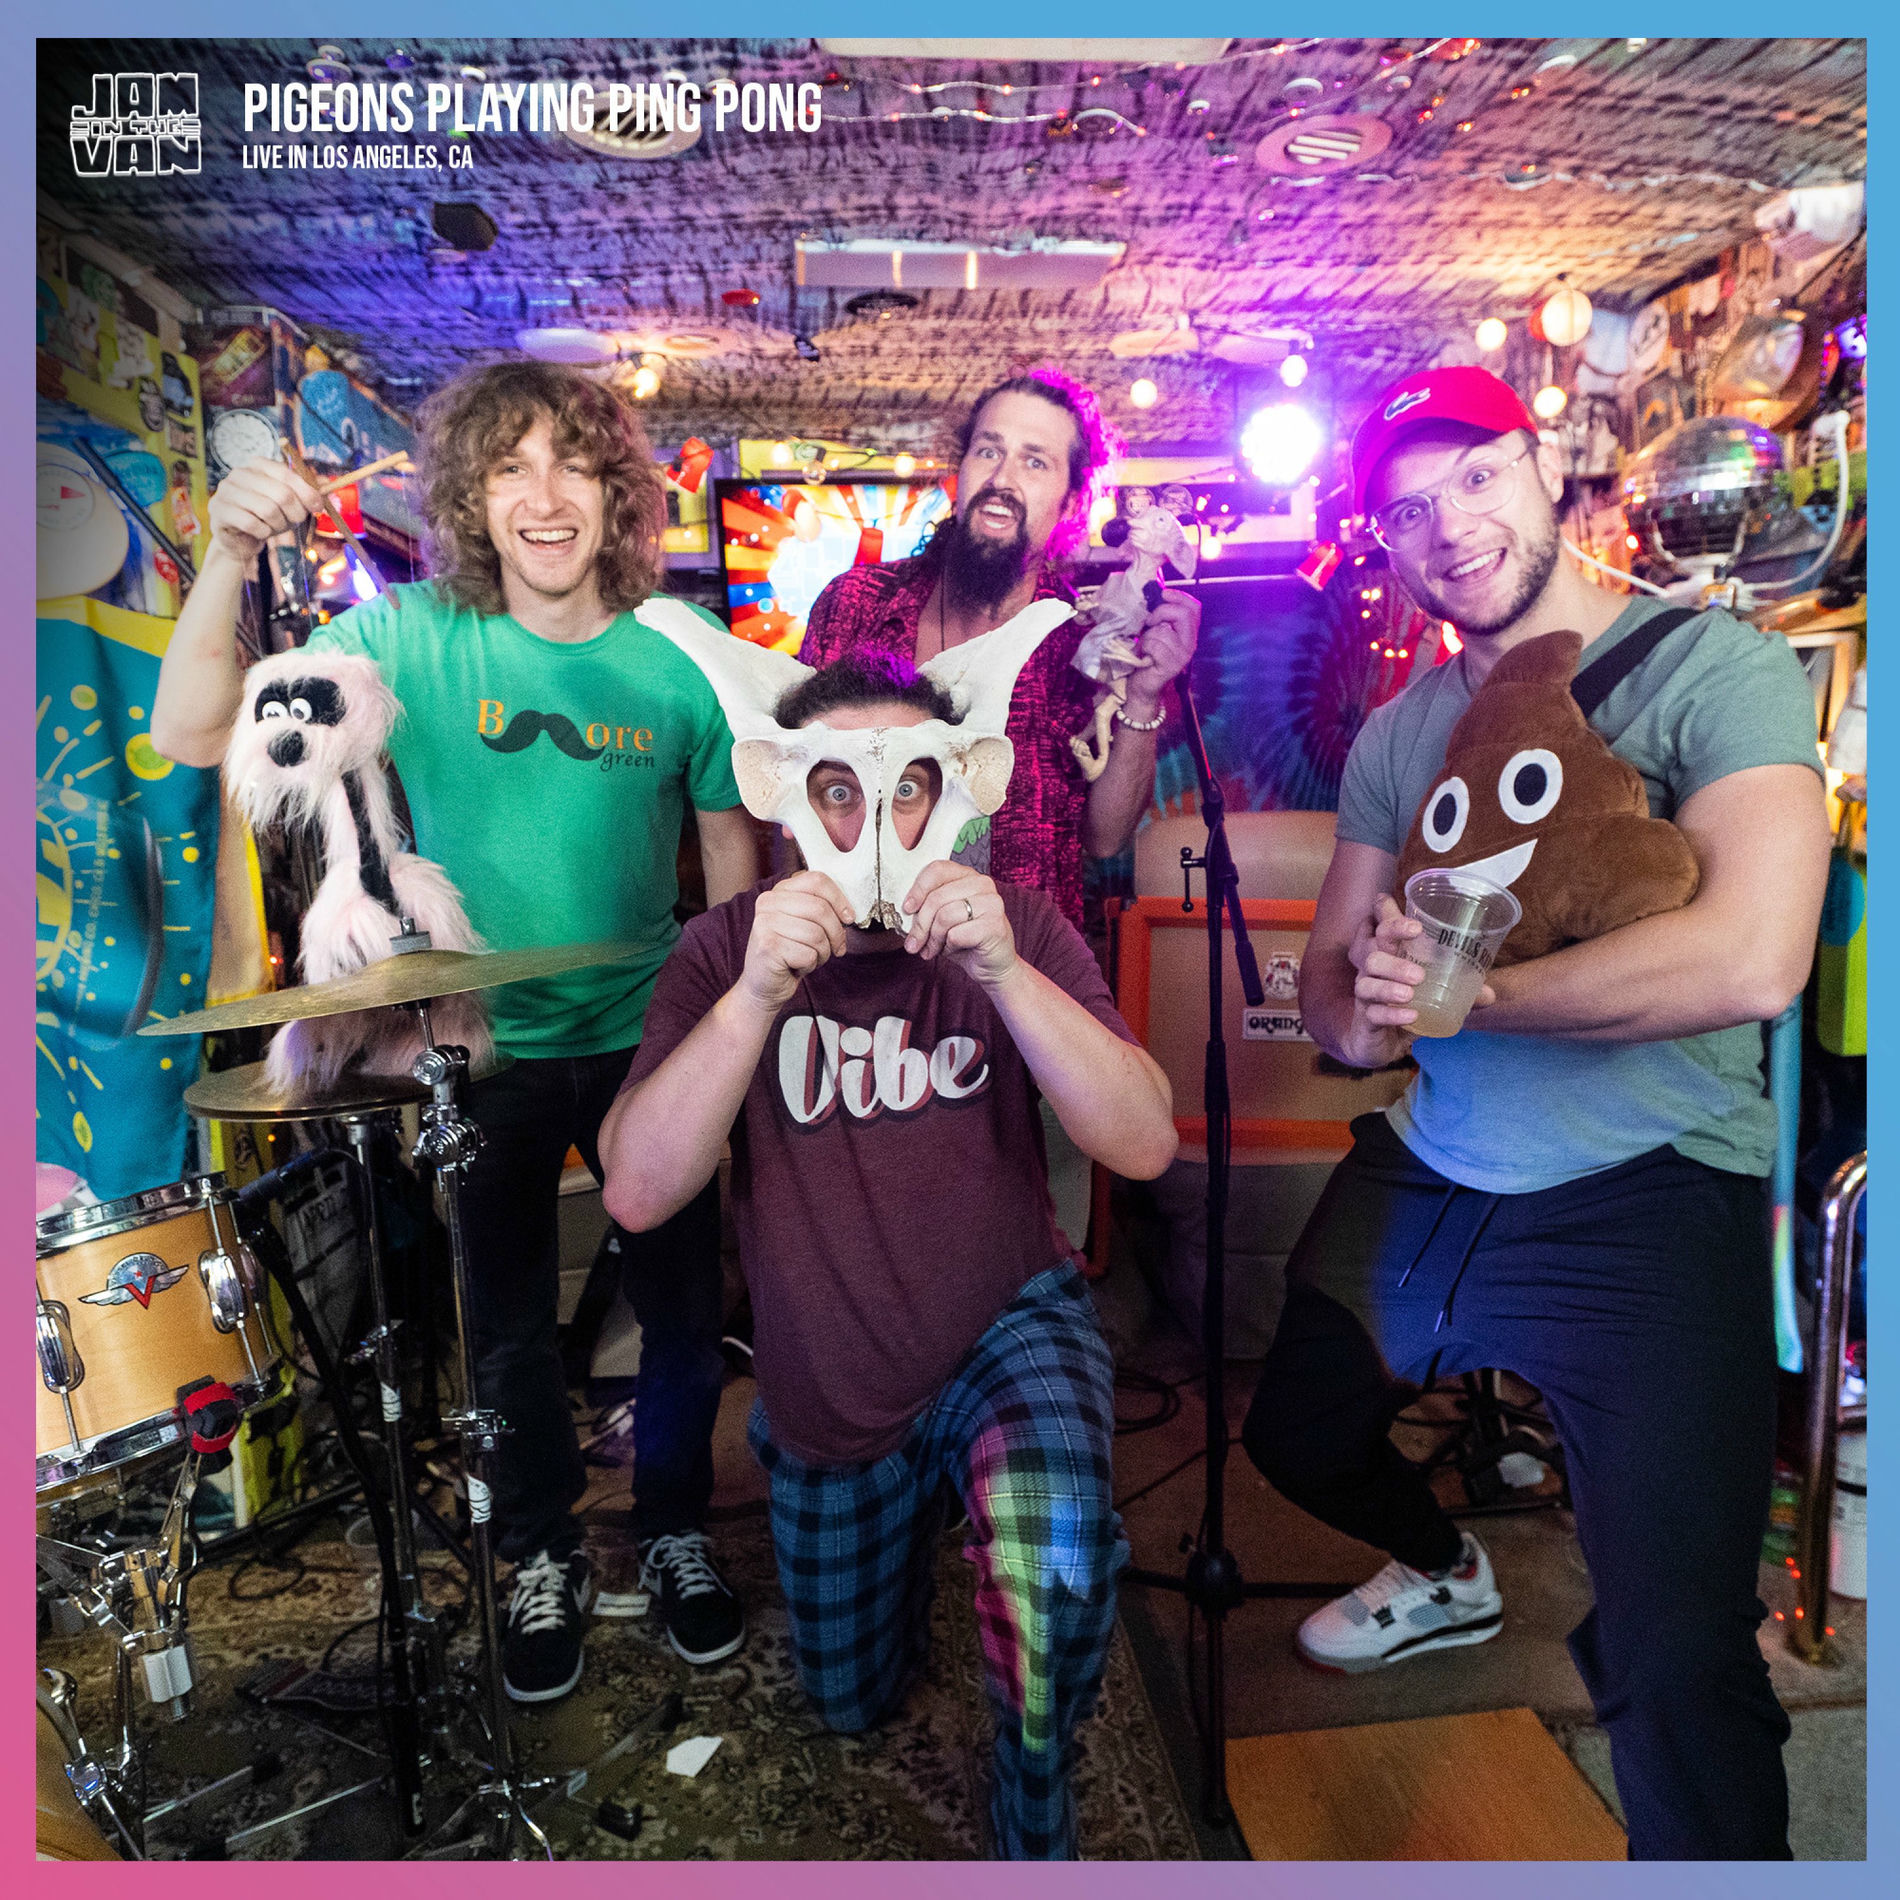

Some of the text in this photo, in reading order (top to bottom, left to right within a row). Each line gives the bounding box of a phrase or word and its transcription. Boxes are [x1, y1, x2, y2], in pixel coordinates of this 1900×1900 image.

[600, 751, 655, 773] green
[1248, 1016, 1305, 1034] ORANG
[779, 1014, 992, 1125] Vibe
